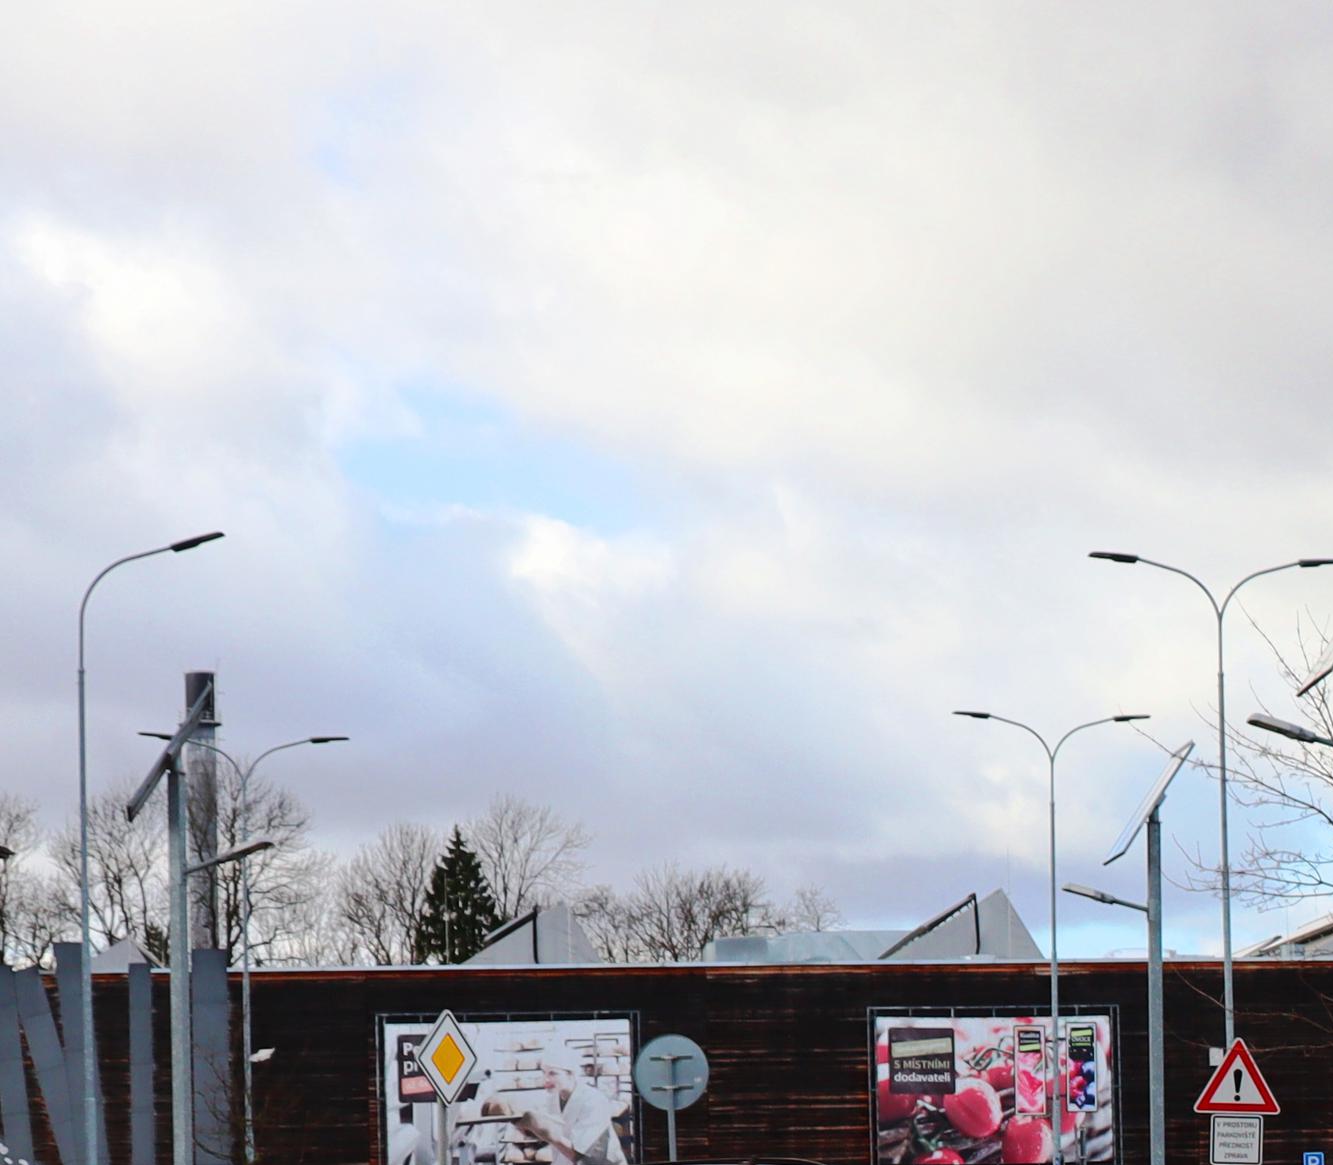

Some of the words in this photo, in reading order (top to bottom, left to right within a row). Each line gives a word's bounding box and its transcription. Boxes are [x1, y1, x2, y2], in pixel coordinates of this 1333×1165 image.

[894, 1060, 901, 1070] S
[903, 1058, 950, 1070] MÍSTNÍMI
[894, 1072, 952, 1083] dodavateli
